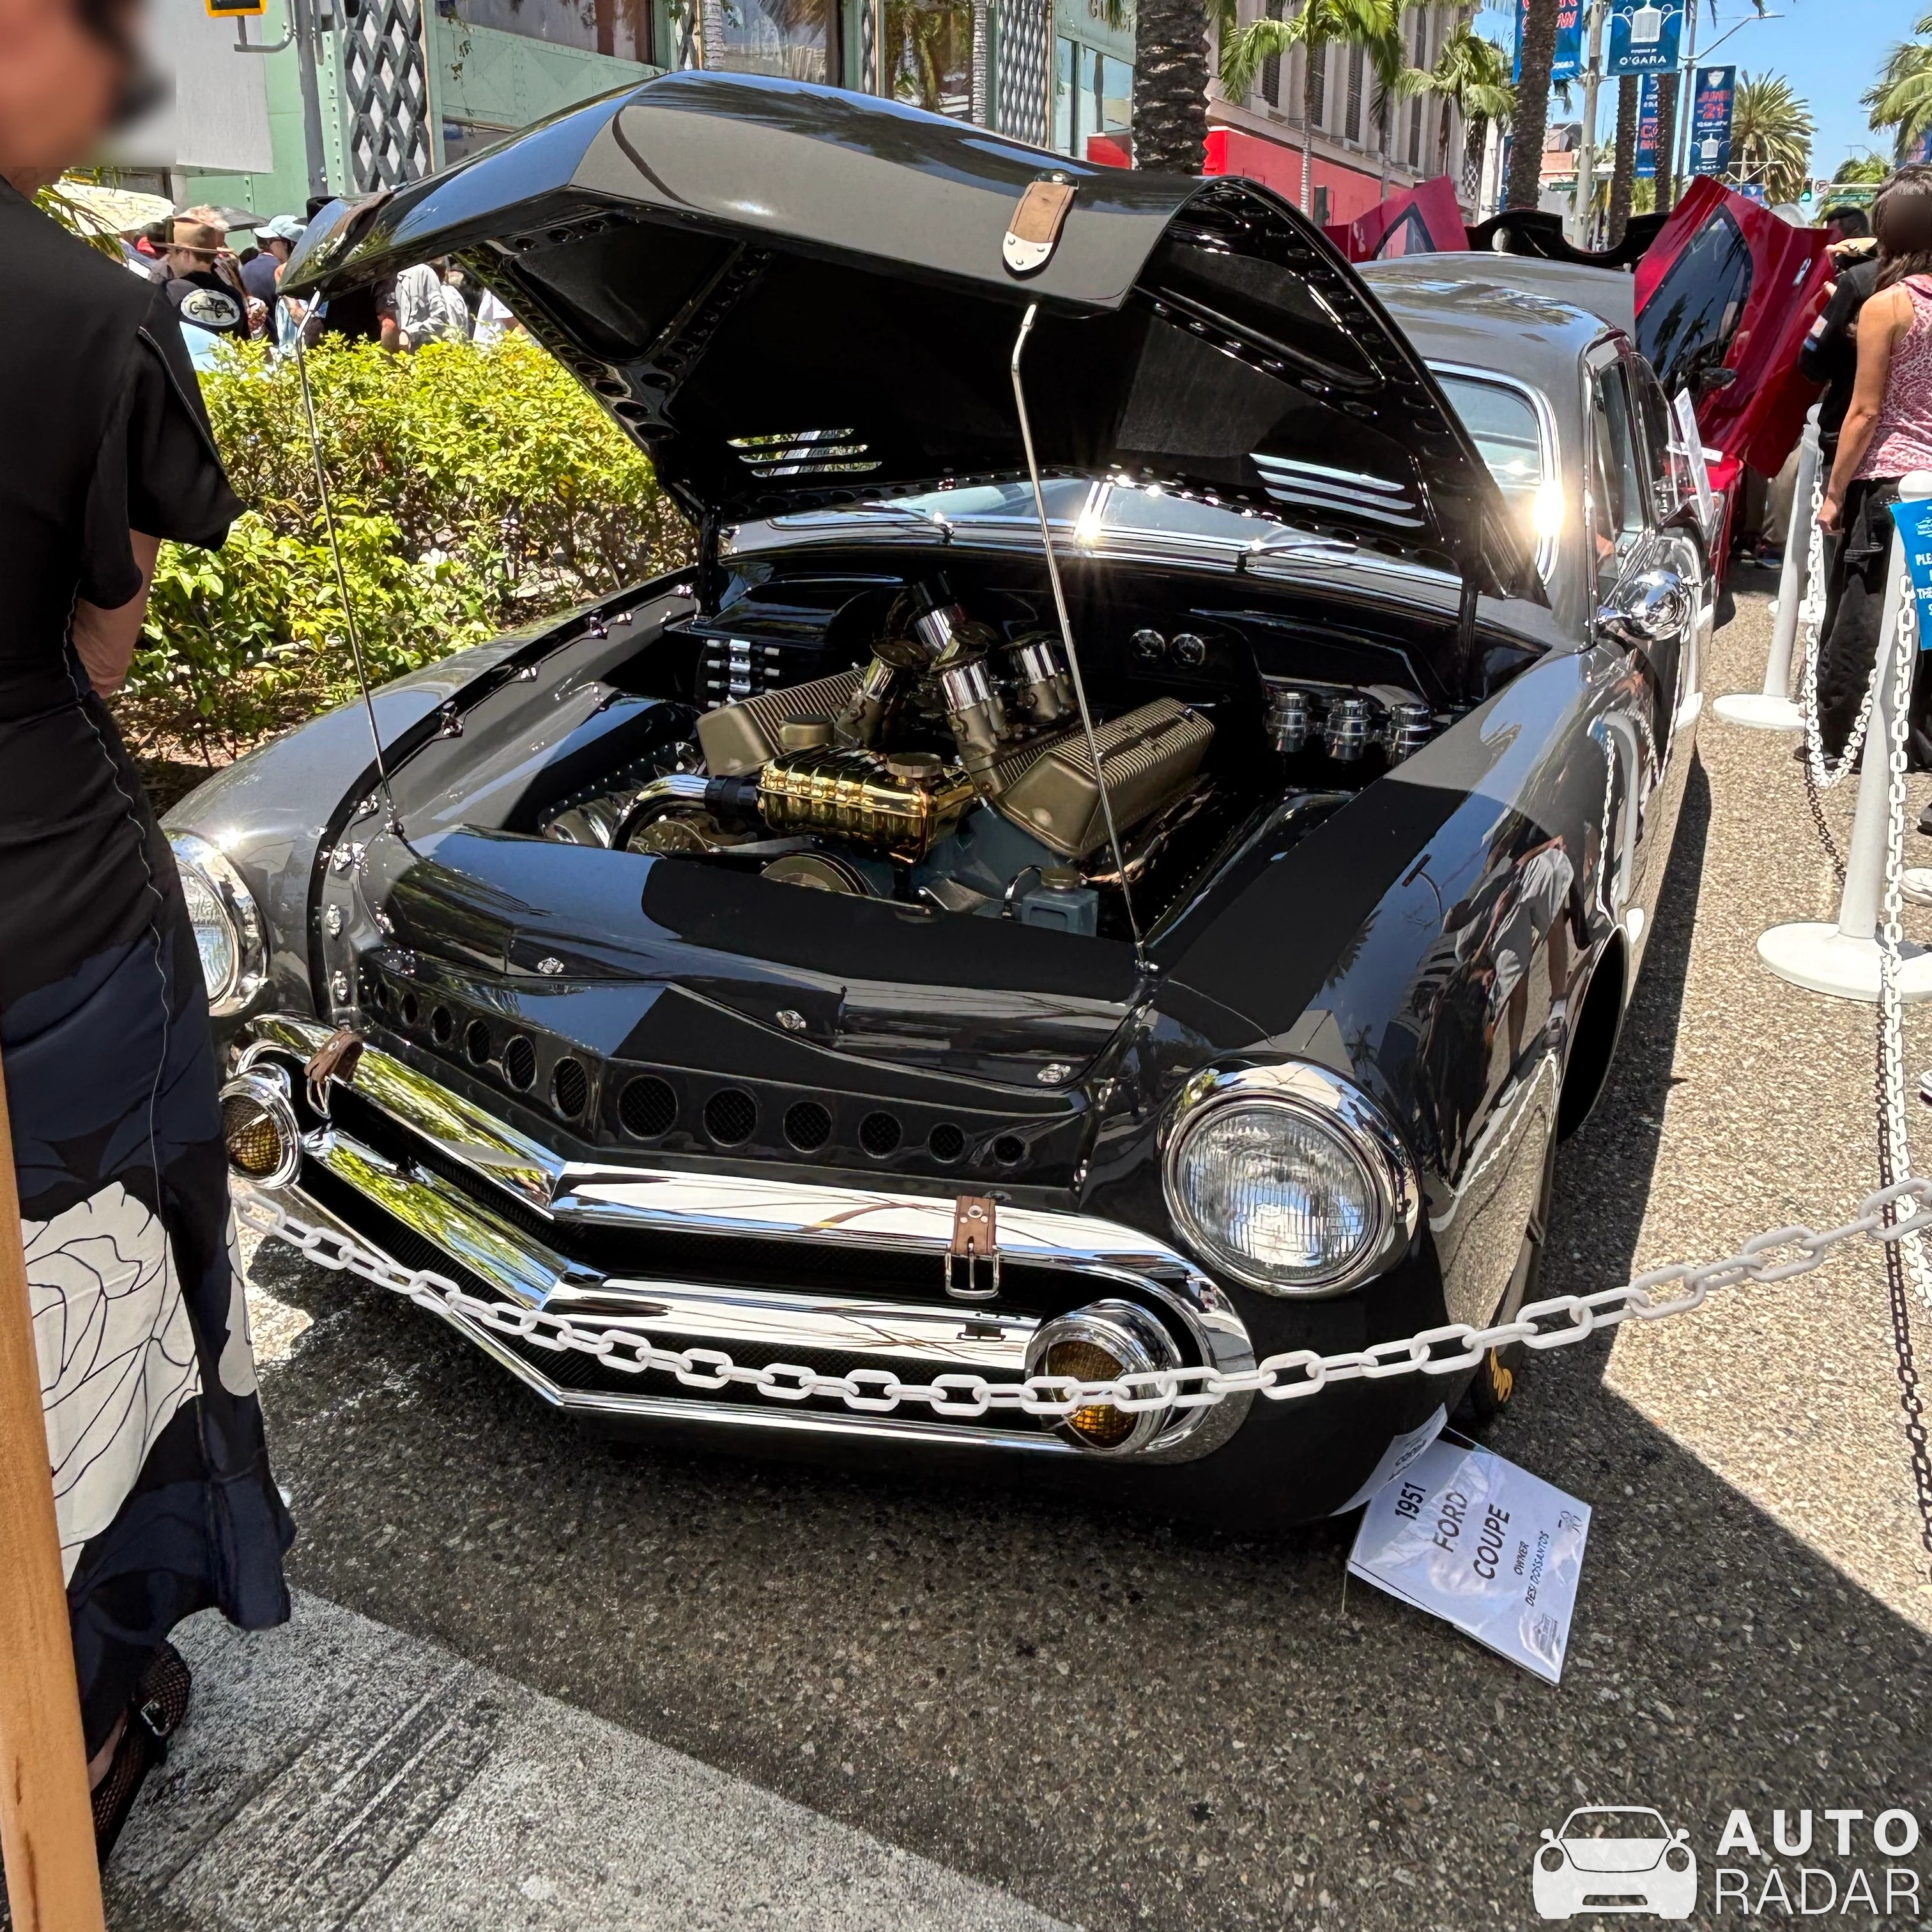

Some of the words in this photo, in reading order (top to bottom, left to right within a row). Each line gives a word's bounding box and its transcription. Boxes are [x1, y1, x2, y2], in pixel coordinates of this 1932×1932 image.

[1619, 56, 1667, 65] O'GARA
[1702, 103, 1724, 119] 21
[1395, 1482, 1426, 1521] 1951
[1432, 1491, 1468, 1553] FORD
[1473, 1503, 1510, 1580] COUPE
[1514, 1540, 1529, 1575] OWNER
[1525, 1583, 1537, 1607] DESI
